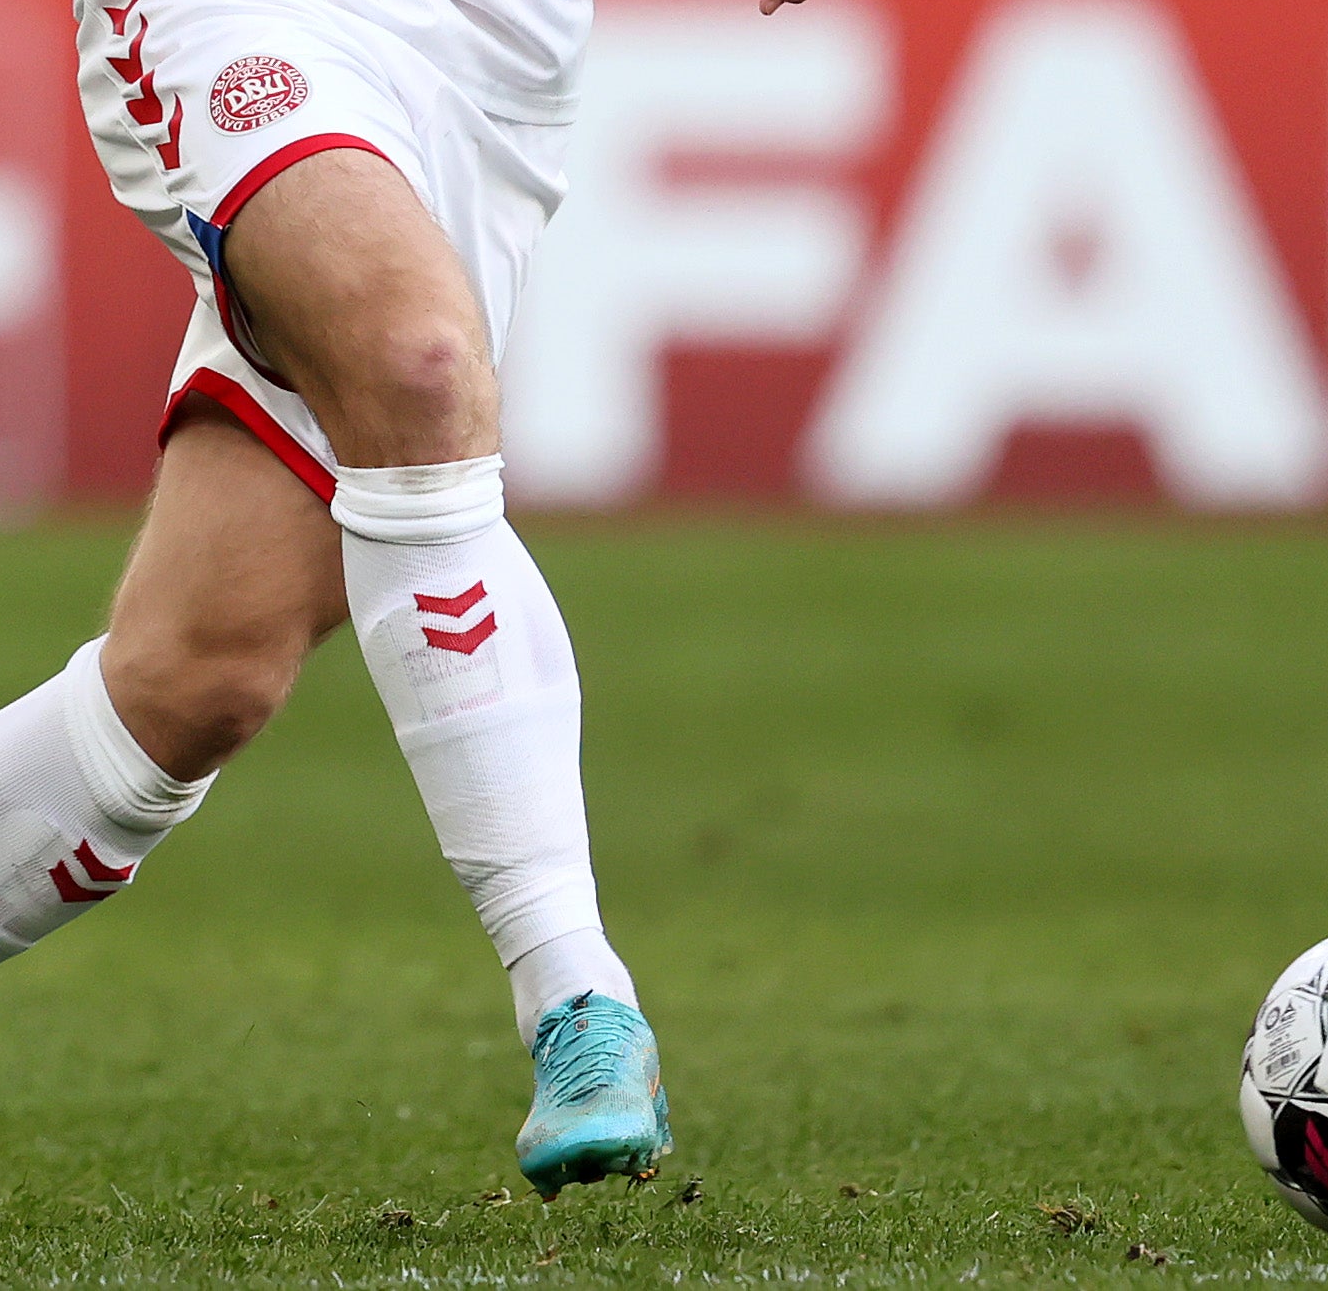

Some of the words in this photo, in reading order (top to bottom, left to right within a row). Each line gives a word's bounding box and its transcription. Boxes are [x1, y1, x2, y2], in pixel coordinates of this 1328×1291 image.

[225, 73, 289, 112] DBU
[211, 95, 244, 131] DANSK
[251, 106, 291, 128] 1889
